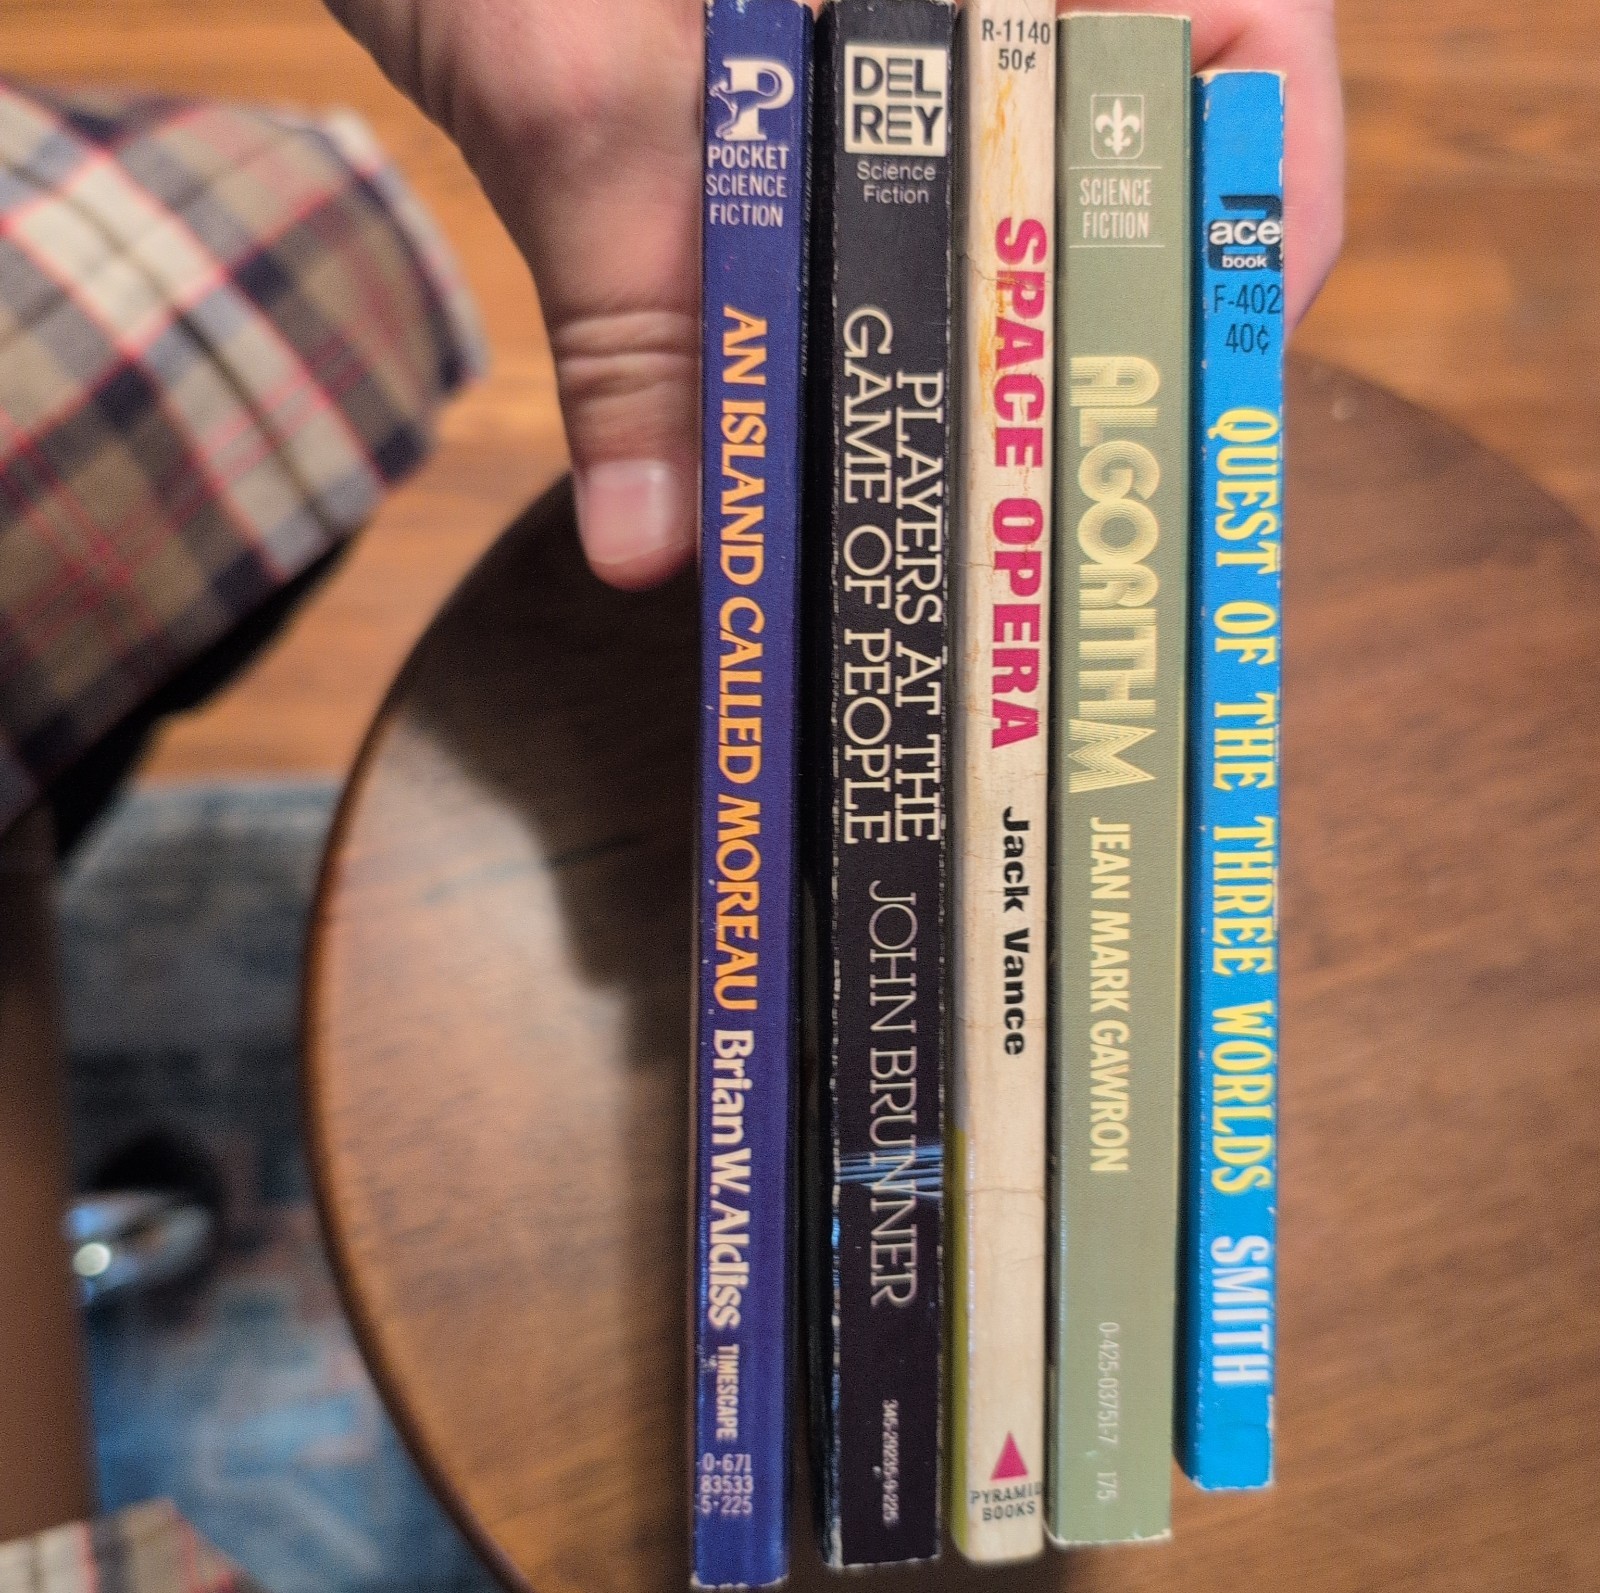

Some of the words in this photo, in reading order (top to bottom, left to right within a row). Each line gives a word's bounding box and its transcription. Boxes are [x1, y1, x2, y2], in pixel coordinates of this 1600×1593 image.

[852, 56, 942, 99] DEL
[981, 19, 1051, 45] R-1140
[998, 49, 1036, 73] 50¢
[707, 146, 789, 169] POCKET
[852, 104, 944, 146] REY
[705, 174, 788, 197] SCIENCE
[709, 203, 783, 227] FICTION
[856, 161, 936, 181] Science
[863, 184, 929, 204] Fiction
[1079, 178, 1152, 206] SCIENCE
[1082, 211, 1149, 238] FICTION
[1209, 220, 1281, 245] ace
[1222, 255, 1267, 268] book
[993, 217, 1047, 468] SPACE
[1213, 284, 1281, 314] F-402
[1225, 323, 1270, 355] 40¢
[722, 305, 768, 385] AN
[843, 308, 893, 503] GAME
[720, 399, 768, 585] ISLAND
[895, 372, 943, 625] PLAYERS
[1207, 408, 1280, 574] QUEST
[843, 524, 892, 609] OF
[1067, 356, 1161, 793] ALGORITHM
[991, 497, 1044, 749] OPERA
[1213, 602, 1277, 665] OF
[718, 596, 766, 784] CALLED
[895, 641, 942, 715] AT
[843, 628, 892, 844] PEOPLE
[1213, 692, 1277, 791] THE
[895, 733, 942, 842] THE
[713, 793, 762, 1011] MOREAU
[1002, 806, 1030, 912] Jack
[1089, 817, 1131, 899] JEAN
[1212, 816, 1275, 976] THREE
[868, 880, 918, 1033] JOHN
[1003, 928, 1030, 1055] Vance
[1089, 910, 1131, 1013] MARK
[711, 1029, 755, 1145] Brian
[1089, 1019, 1131, 1172] GAWRON
[1211, 1000, 1274, 1192] WORLDS
[710, 1147, 751, 1196] W.
[869, 1046, 917, 1307] BRUNNER
[708, 1200, 750, 1330] Aldiss
[1210, 1235, 1271, 1384] SMITH
[715, 1344, 740, 1442] TIMESCAPE
[700, 1475, 754, 1494] 83533
[982, 1500, 1035, 1521] BOOKS
[1097, 1471, 1118, 1501] 175
